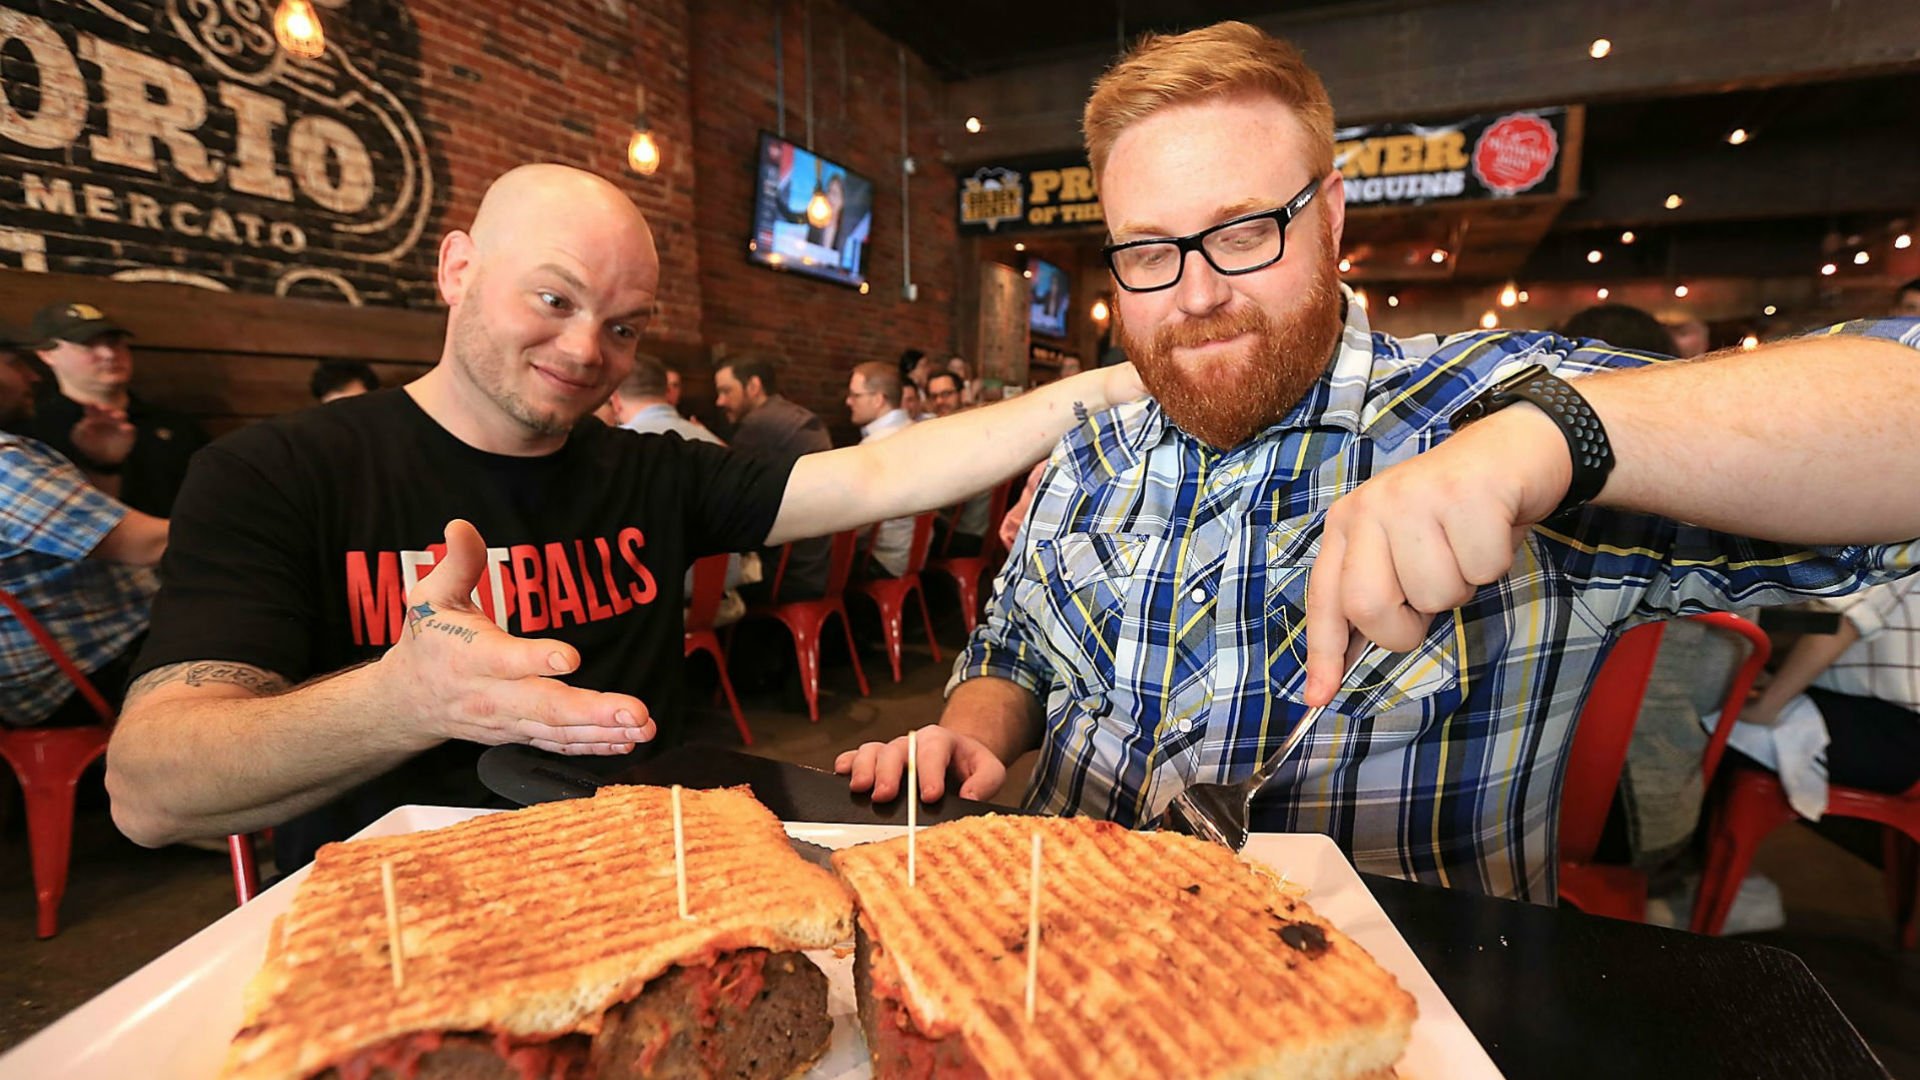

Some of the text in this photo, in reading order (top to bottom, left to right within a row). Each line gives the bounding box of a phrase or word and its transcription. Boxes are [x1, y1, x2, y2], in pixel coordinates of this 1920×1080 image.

[0, 5, 375, 214] ORIO
[1028, 207, 1058, 225] OF
[1060, 202, 1103, 223] THE
[1343, 171, 1466, 204] NGUINS
[1029, 166, 1096, 204] PR
[1333, 131, 1469, 178] NER
[23, 172, 307, 255] MERCATO
[345, 526, 657, 646] MTBALLS
